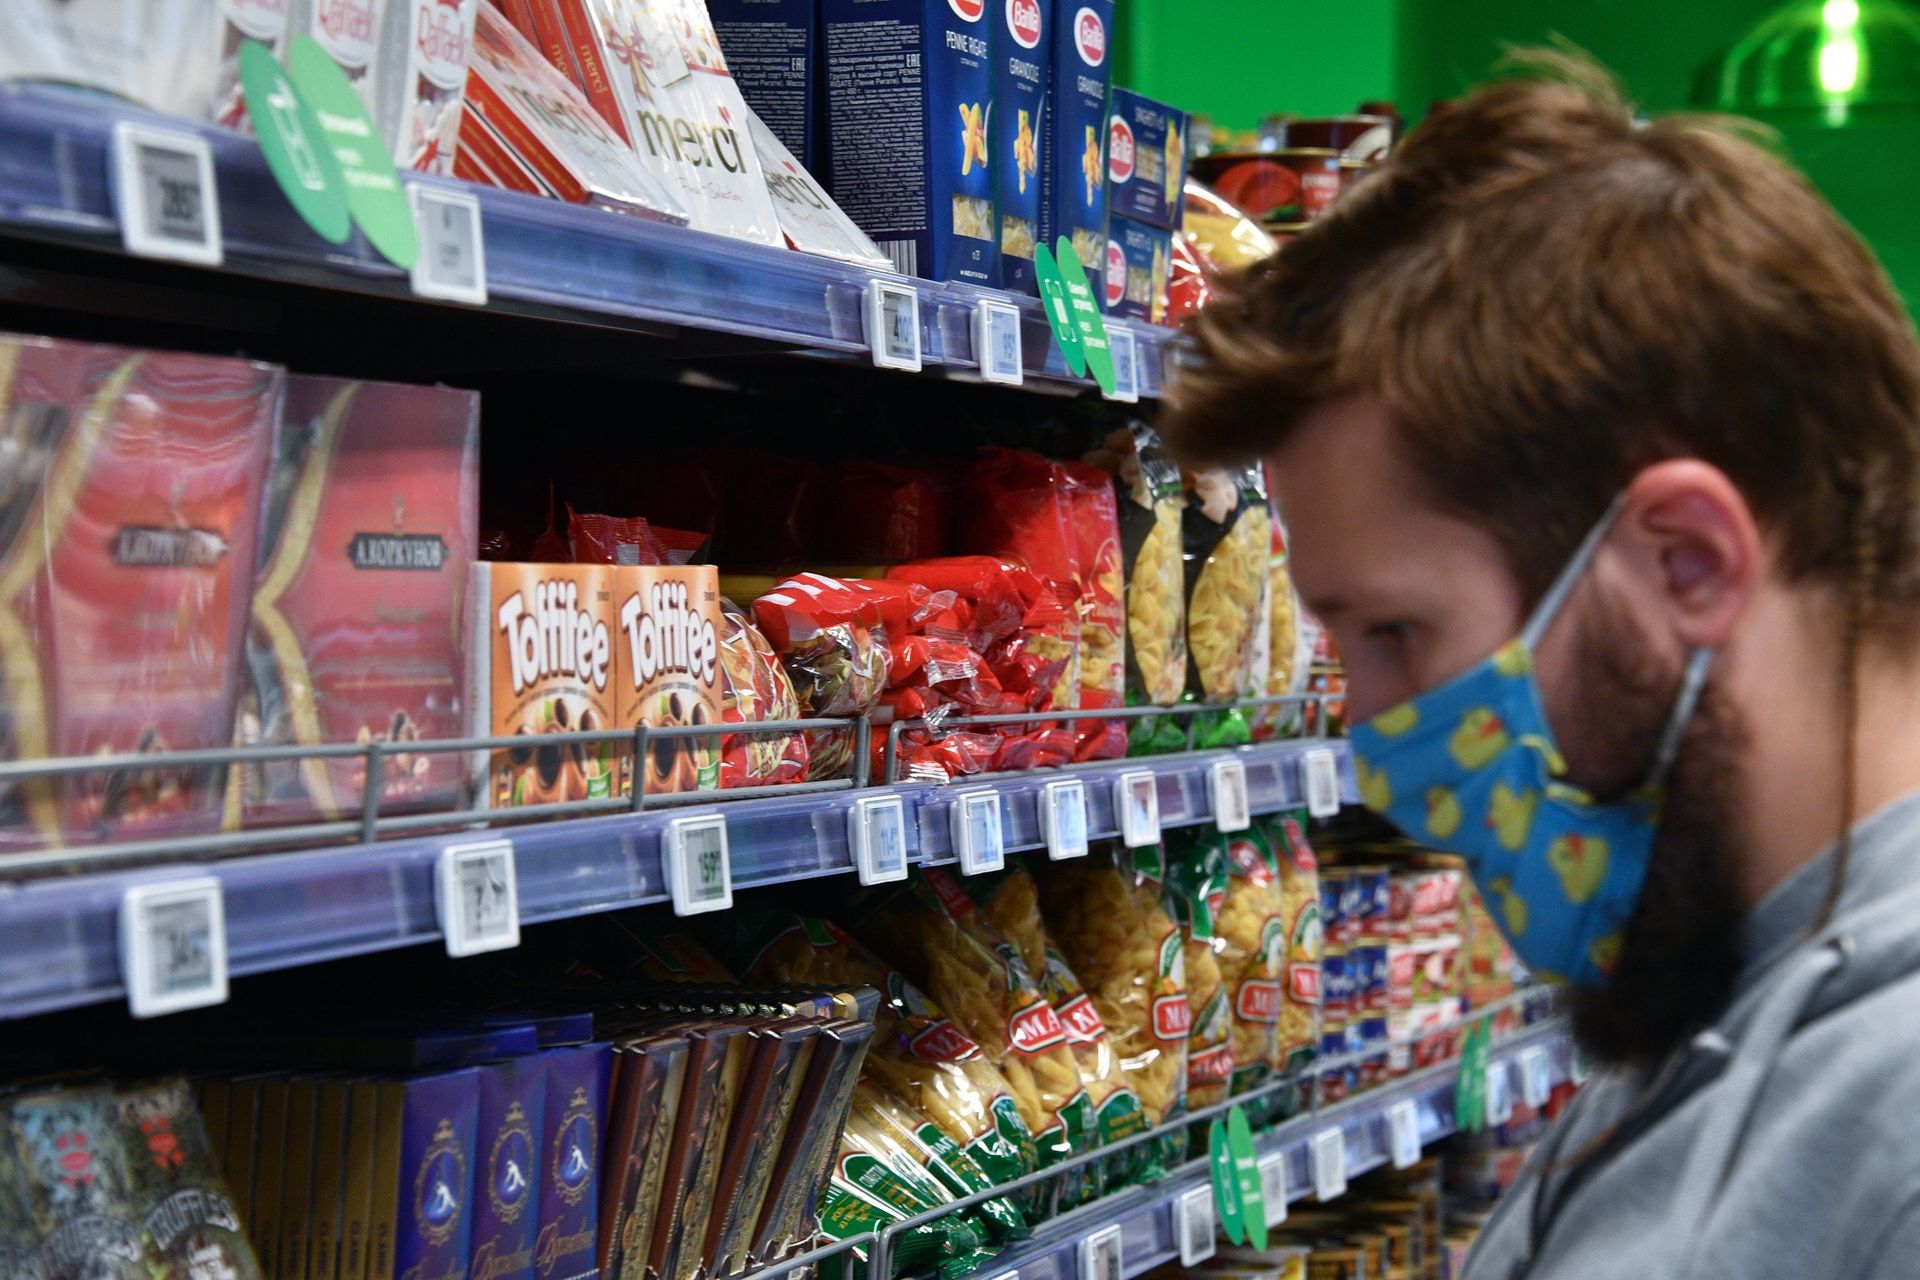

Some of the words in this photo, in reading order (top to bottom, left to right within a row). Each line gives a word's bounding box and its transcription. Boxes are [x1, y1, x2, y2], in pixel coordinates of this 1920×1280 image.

[1015, 1, 1039, 33] Barilla
[1082, 20, 1103, 51] Barilla
[580, 43, 609, 94] merci
[946, 30, 968, 52] PENNE
[969, 37, 988, 60] RIGATE
[636, 106, 747, 174] merci
[763, 160, 831, 210] erci
[498, 578, 611, 697] Toffifee
[620, 578, 717, 693] Toffifee
[145, 1188, 239, 1251] TRUFFLES
